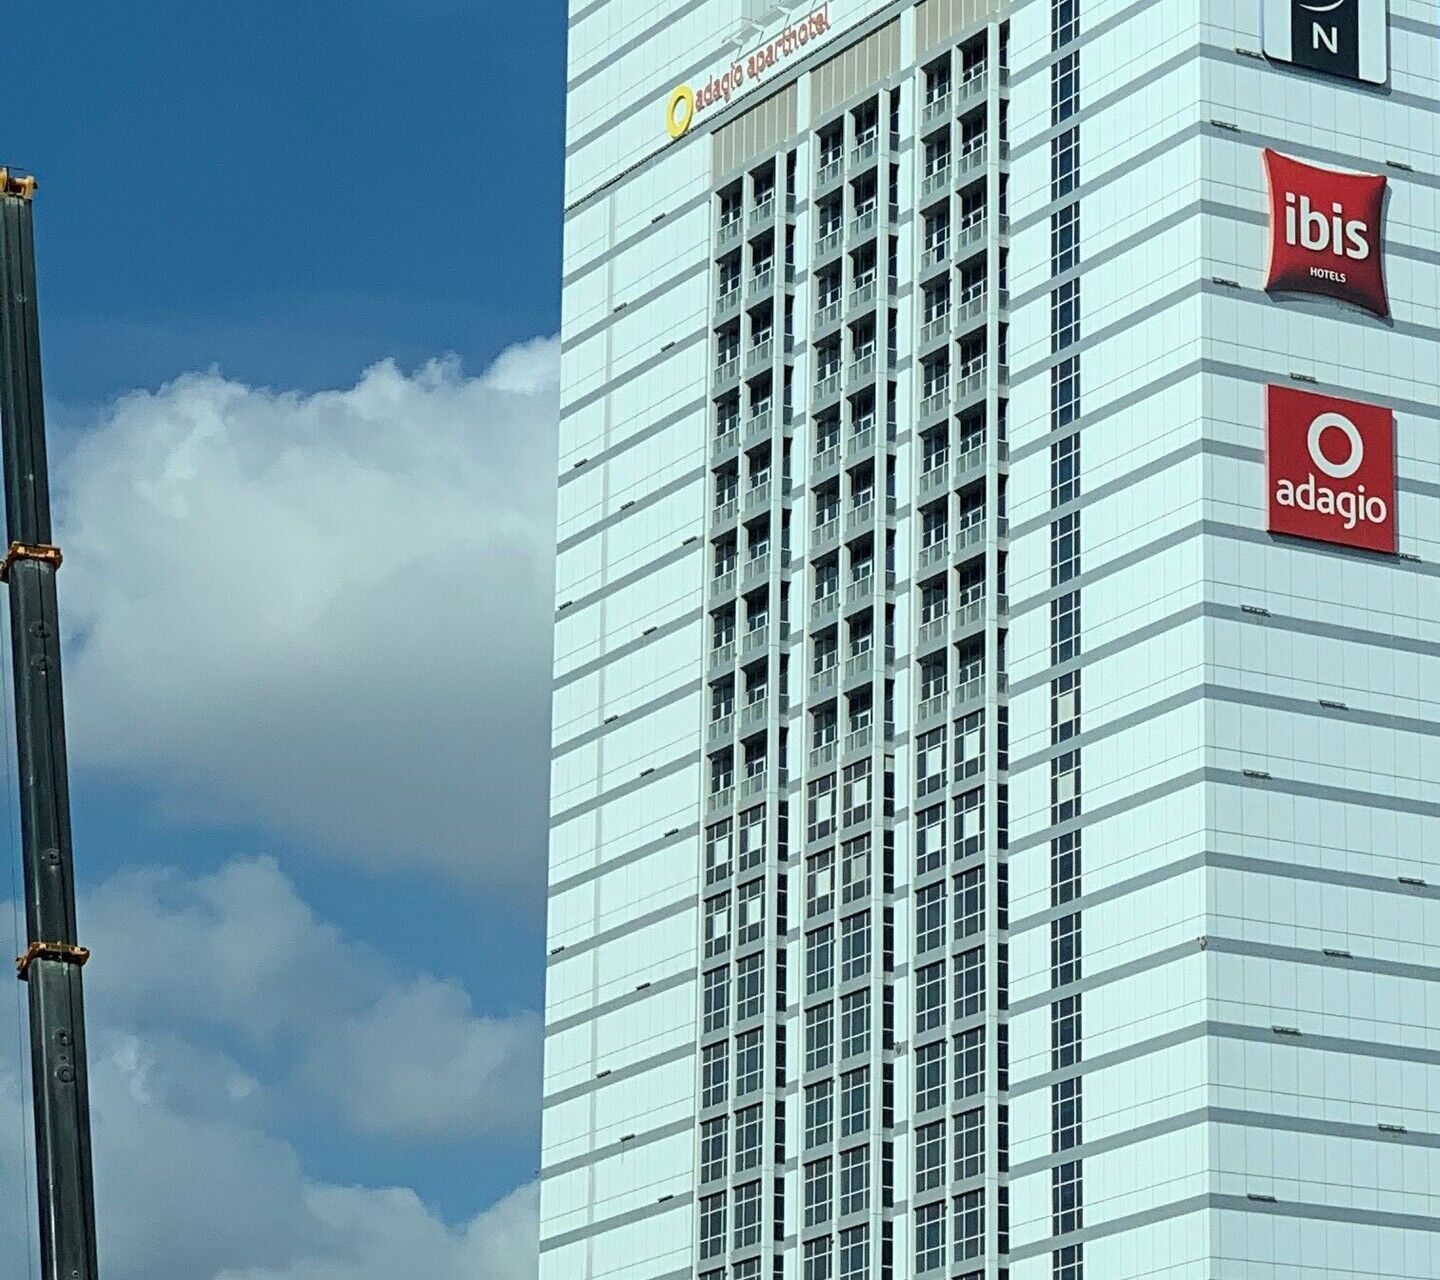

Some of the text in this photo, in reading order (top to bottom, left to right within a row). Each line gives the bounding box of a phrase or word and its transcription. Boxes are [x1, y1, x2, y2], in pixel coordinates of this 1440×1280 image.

[695, 2, 831, 112] adagio aparthotel
[1311, 21, 1338, 54] N
[1285, 193, 1369, 260] ibis
[1309, 266, 1347, 284] HOTELS
[1275, 477, 1387, 530] adagio
